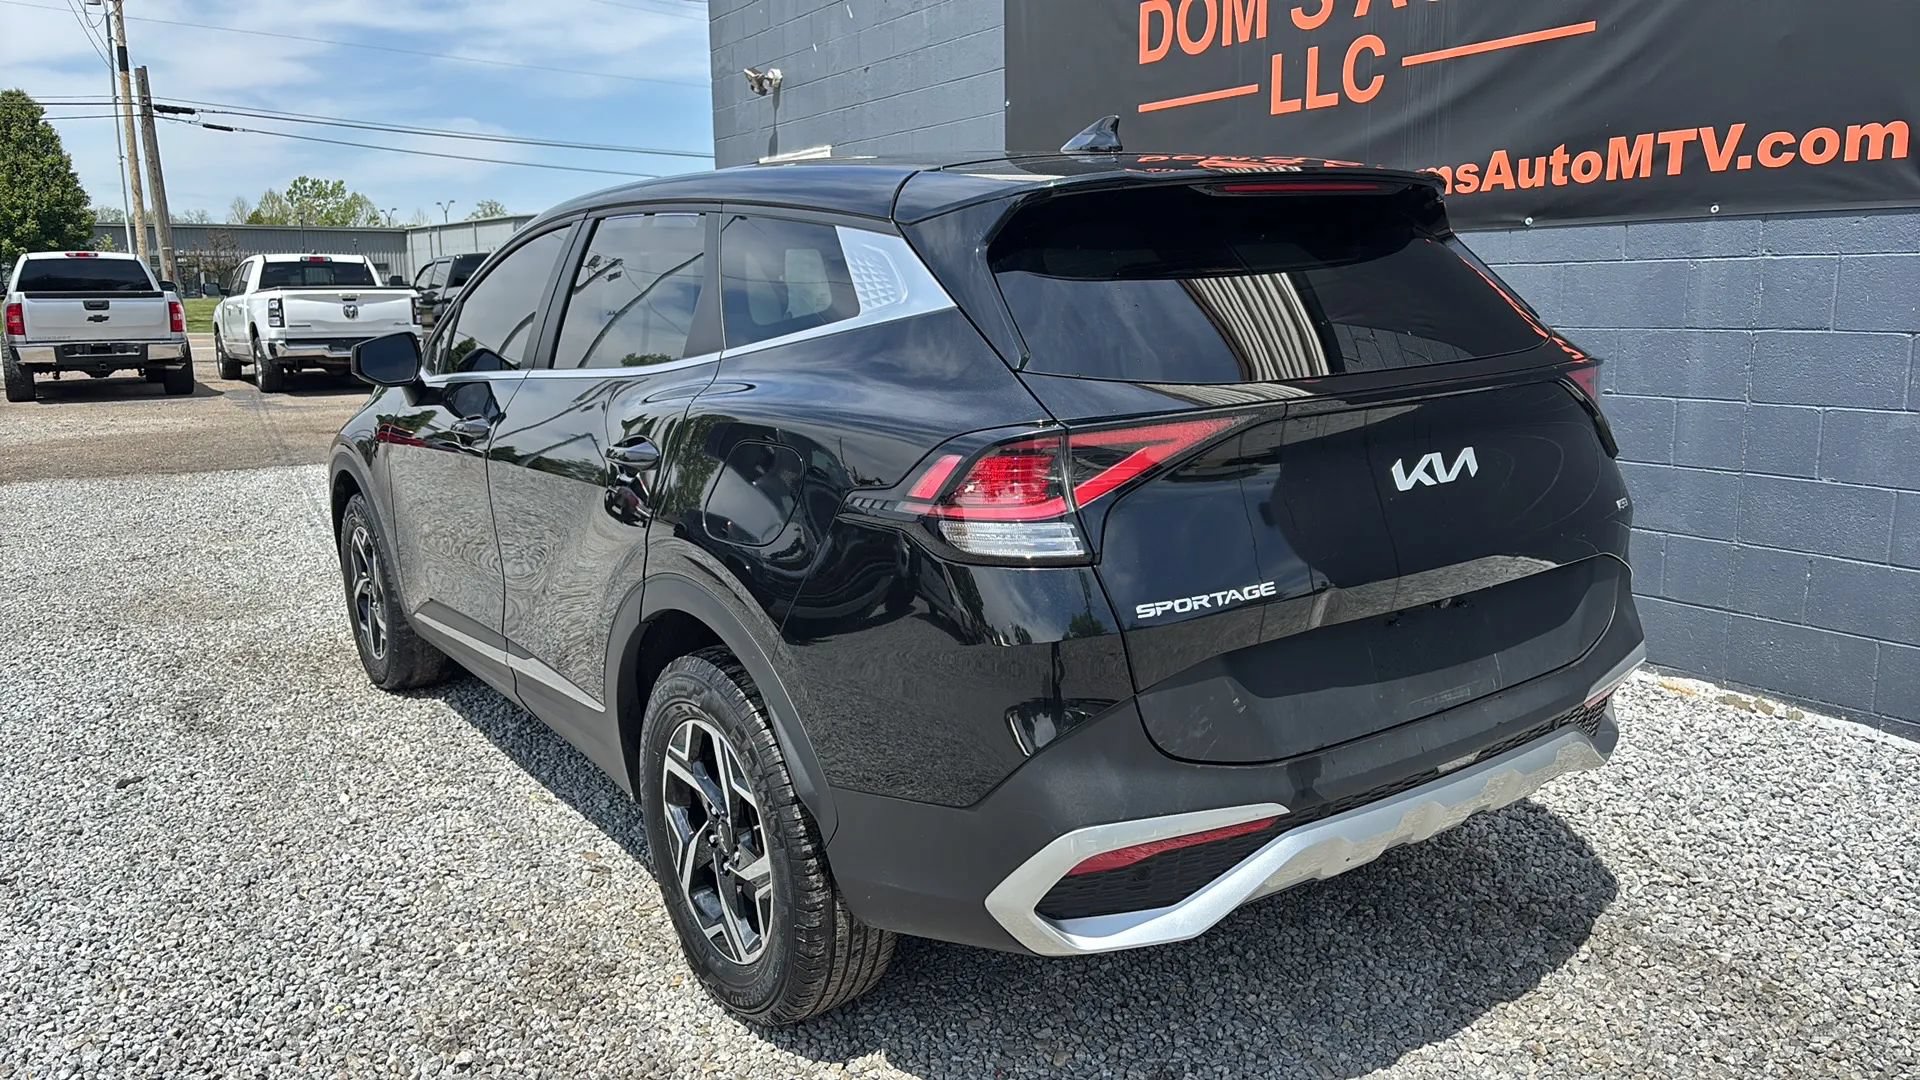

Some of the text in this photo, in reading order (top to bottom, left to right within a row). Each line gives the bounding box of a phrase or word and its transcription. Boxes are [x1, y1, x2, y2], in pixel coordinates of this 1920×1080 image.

[1139, 0, 1334, 64] DOM
[1270, 34, 1386, 115] LLC
[1415, 120, 1909, 195] sAutoMTV.com
[1391, 446, 1479, 492] KIA
[1135, 581, 1277, 619] SPORTAGE
